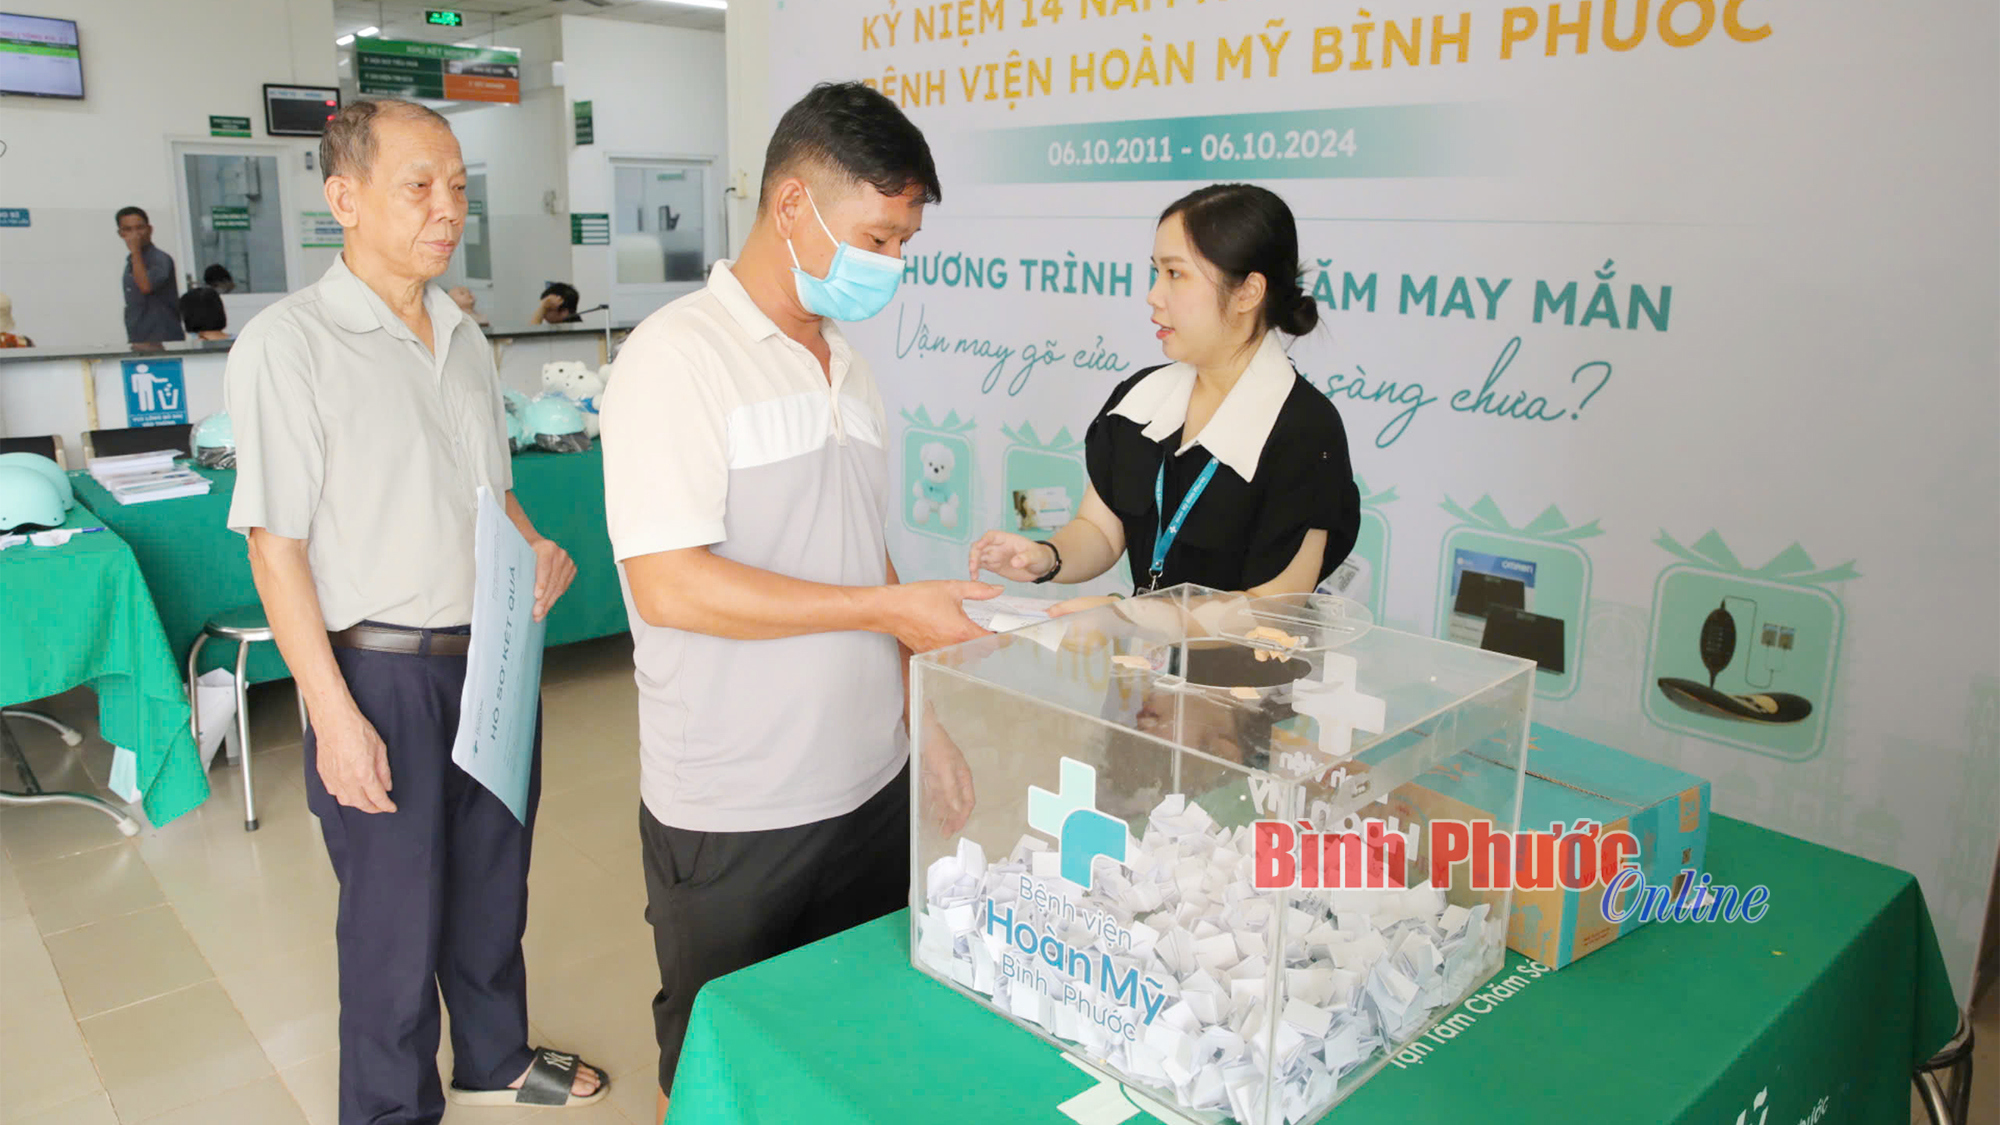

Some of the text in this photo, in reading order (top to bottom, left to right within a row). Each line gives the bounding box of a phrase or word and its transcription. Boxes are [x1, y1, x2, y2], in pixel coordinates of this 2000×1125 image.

[861, 7, 902, 51] KỶ
[913, 0, 1004, 47] NIỆM
[1021, 0, 1063, 28] 14
[960, 49, 1052, 110] VIỆN
[1069, 33, 1195, 94] HOÀN
[1215, 17, 1291, 82] MỸ
[1311, 8, 1471, 74] BÌNH
[1048, 136, 1173, 167] 06.10.2011
[1200, 129, 1357, 164] 06.10.2024
[902, 251, 1008, 290] HƯƠNG
[1019, 249, 1133, 298] TRÌNH
[1398, 273, 1512, 321] MAY
[1532, 258, 1673, 333] MẮN
[896, 302, 1614, 450] Vận may gõ cửa sàng chưa?
[1019, 874, 1133, 951] Bệnh viện
[985, 898, 1168, 1026] Hoàn Mỹ
[1001, 952, 1137, 1043] Bình Phước
[1464, 974, 1531, 1014] Chăm
